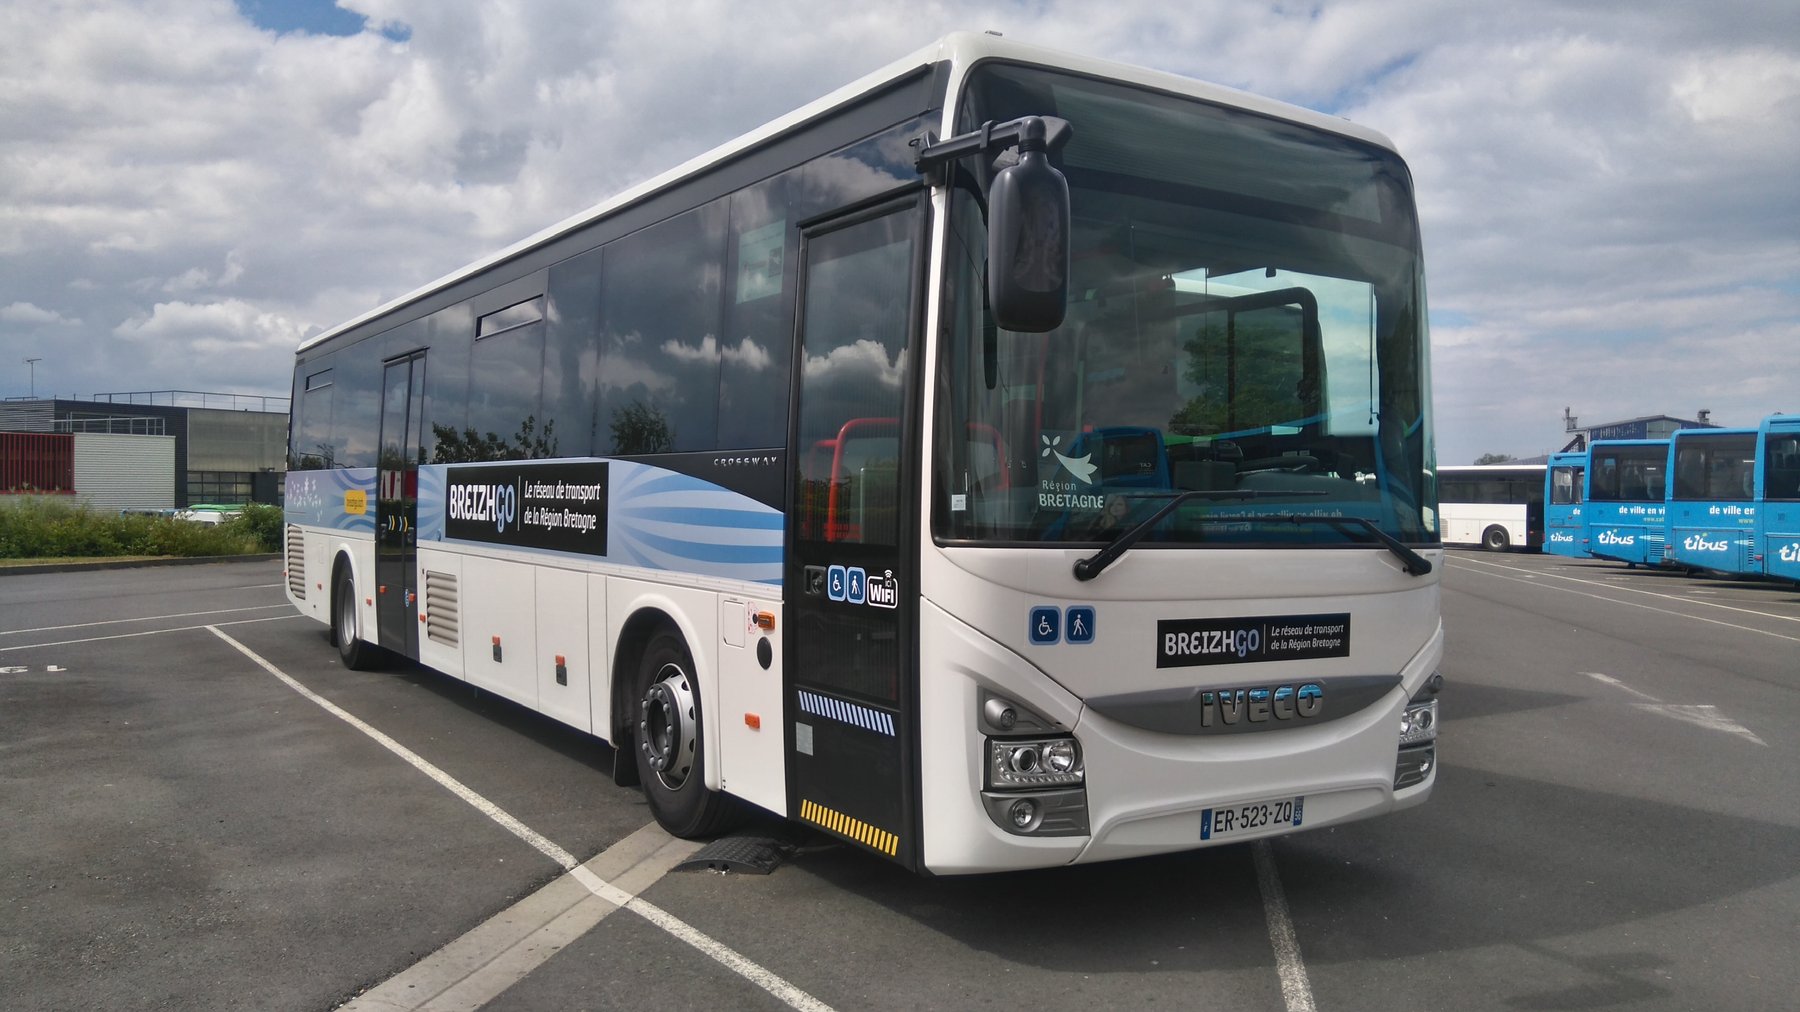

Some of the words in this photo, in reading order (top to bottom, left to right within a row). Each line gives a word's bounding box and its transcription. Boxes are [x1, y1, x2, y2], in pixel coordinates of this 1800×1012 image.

[713, 456, 777, 467] CROSSWAY
[524, 480, 533, 498] Le
[533, 480, 555, 499] réseau
[555, 479, 565, 499] de
[565, 482, 601, 504] transport
[1042, 479, 1077, 492] Région
[450, 484, 515, 533] BREIZHGO
[1619, 506, 1629, 514] de
[1630, 506, 1646, 515] ville
[1647, 507, 1657, 515] en
[1709, 505, 1720, 515] de
[1722, 505, 1742, 515] ville
[524, 506, 532, 524] de
[532, 506, 540, 525] la
[540, 507, 563, 531] Région
[563, 508, 597, 534] Bretagne
[1550, 532, 1574, 542] tibus
[1598, 529, 1634, 545] tibus
[1683, 533, 1728, 551] tibus
[1271, 626, 1281, 636] Le
[1281, 625, 1304, 636] réseau
[1304, 624, 1313, 635] de
[1313, 624, 1344, 636] transport
[1165, 629, 1260, 658] BREIZHGO
[1270, 640, 1280, 650] de
[1281, 639, 1288, 649] la
[1288, 639, 1311, 651] Région
[1311, 637, 1341, 649] Bretagne
[1201, 684, 1324, 727] IVECO
